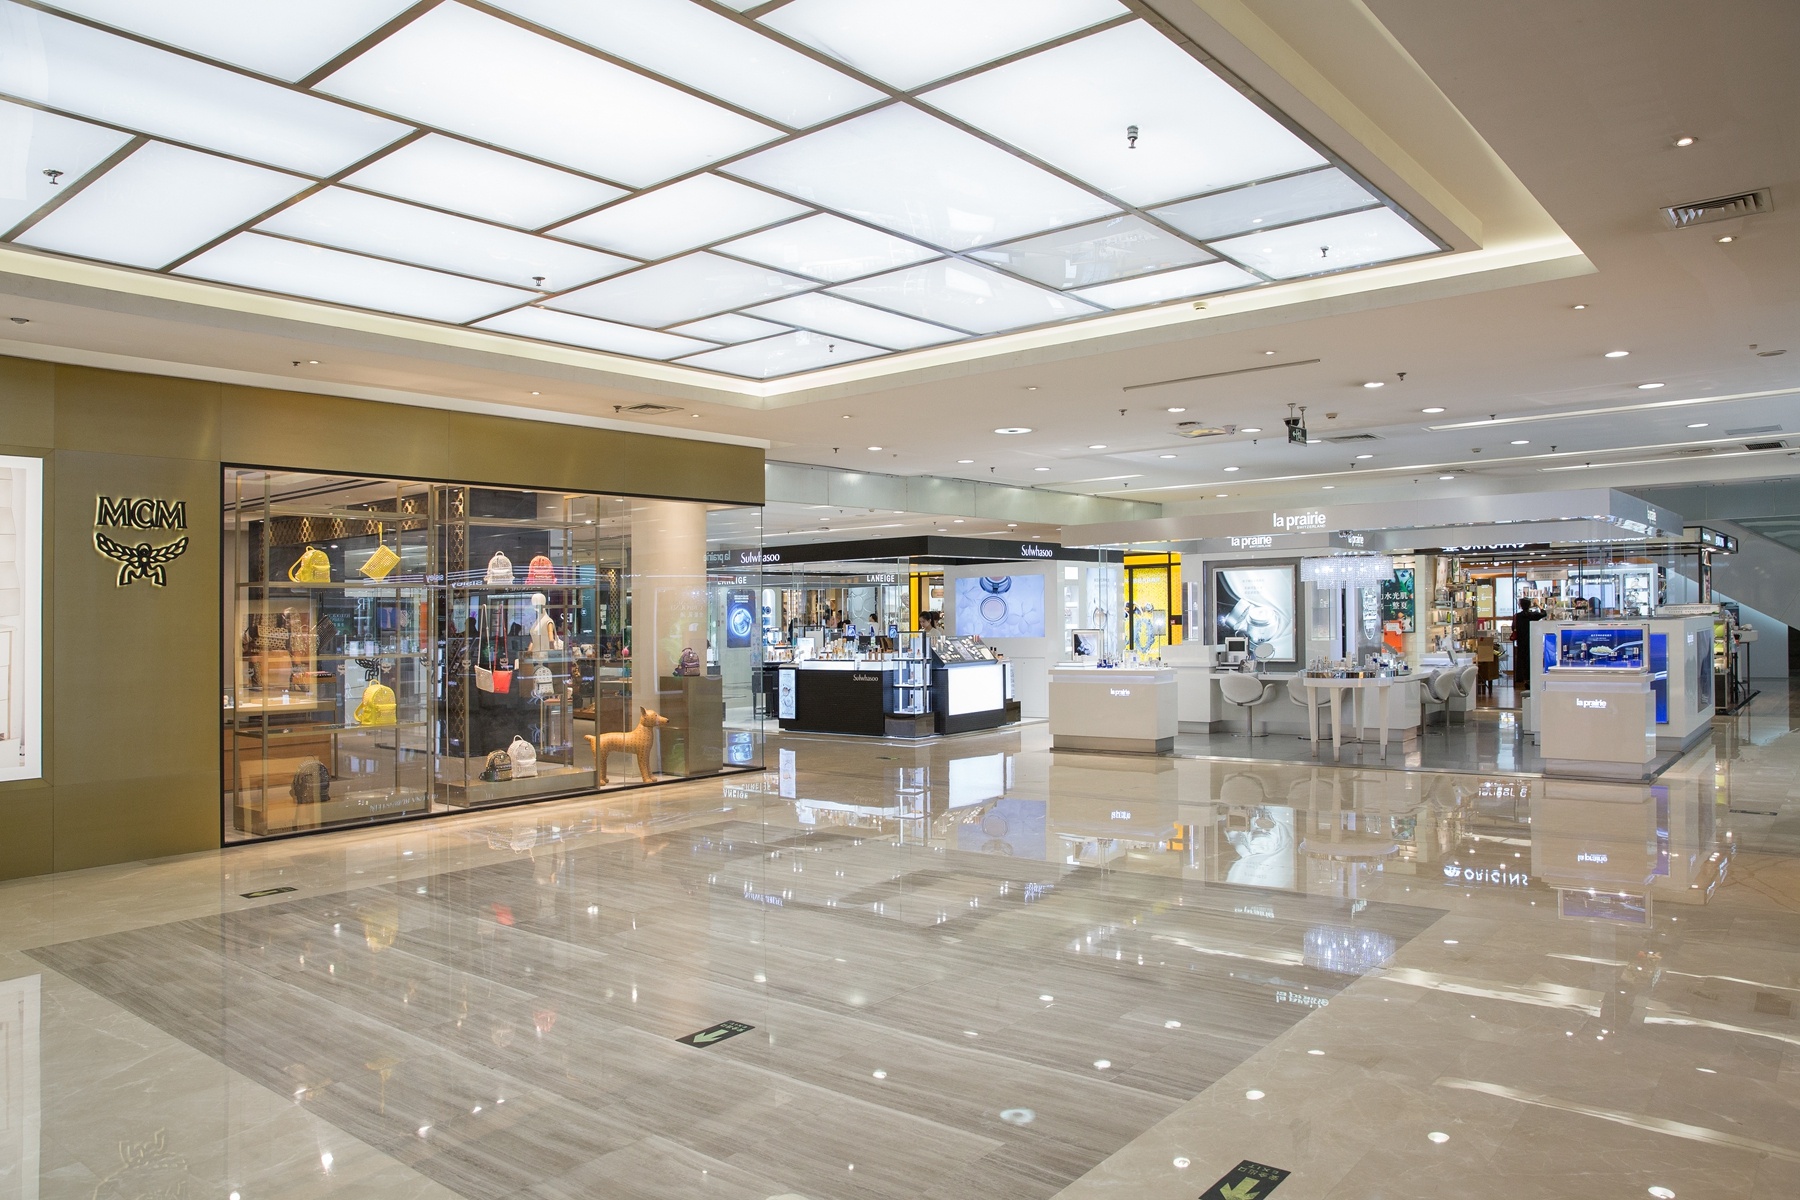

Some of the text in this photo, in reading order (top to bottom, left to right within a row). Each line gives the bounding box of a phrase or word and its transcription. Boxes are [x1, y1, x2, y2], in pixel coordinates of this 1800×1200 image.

[97, 496, 188, 529] MCM
[1273, 511, 1326, 531] la prairie
[1231, 537, 1240, 546] la
[1241, 536, 1272, 549] prairie
[1021, 544, 1053, 557] Sulwhasoo
[740, 551, 780, 564] Sulwhasoo
[866, 574, 895, 582] LANEIGE
[853, 674, 878, 682] Sulwhasoo
